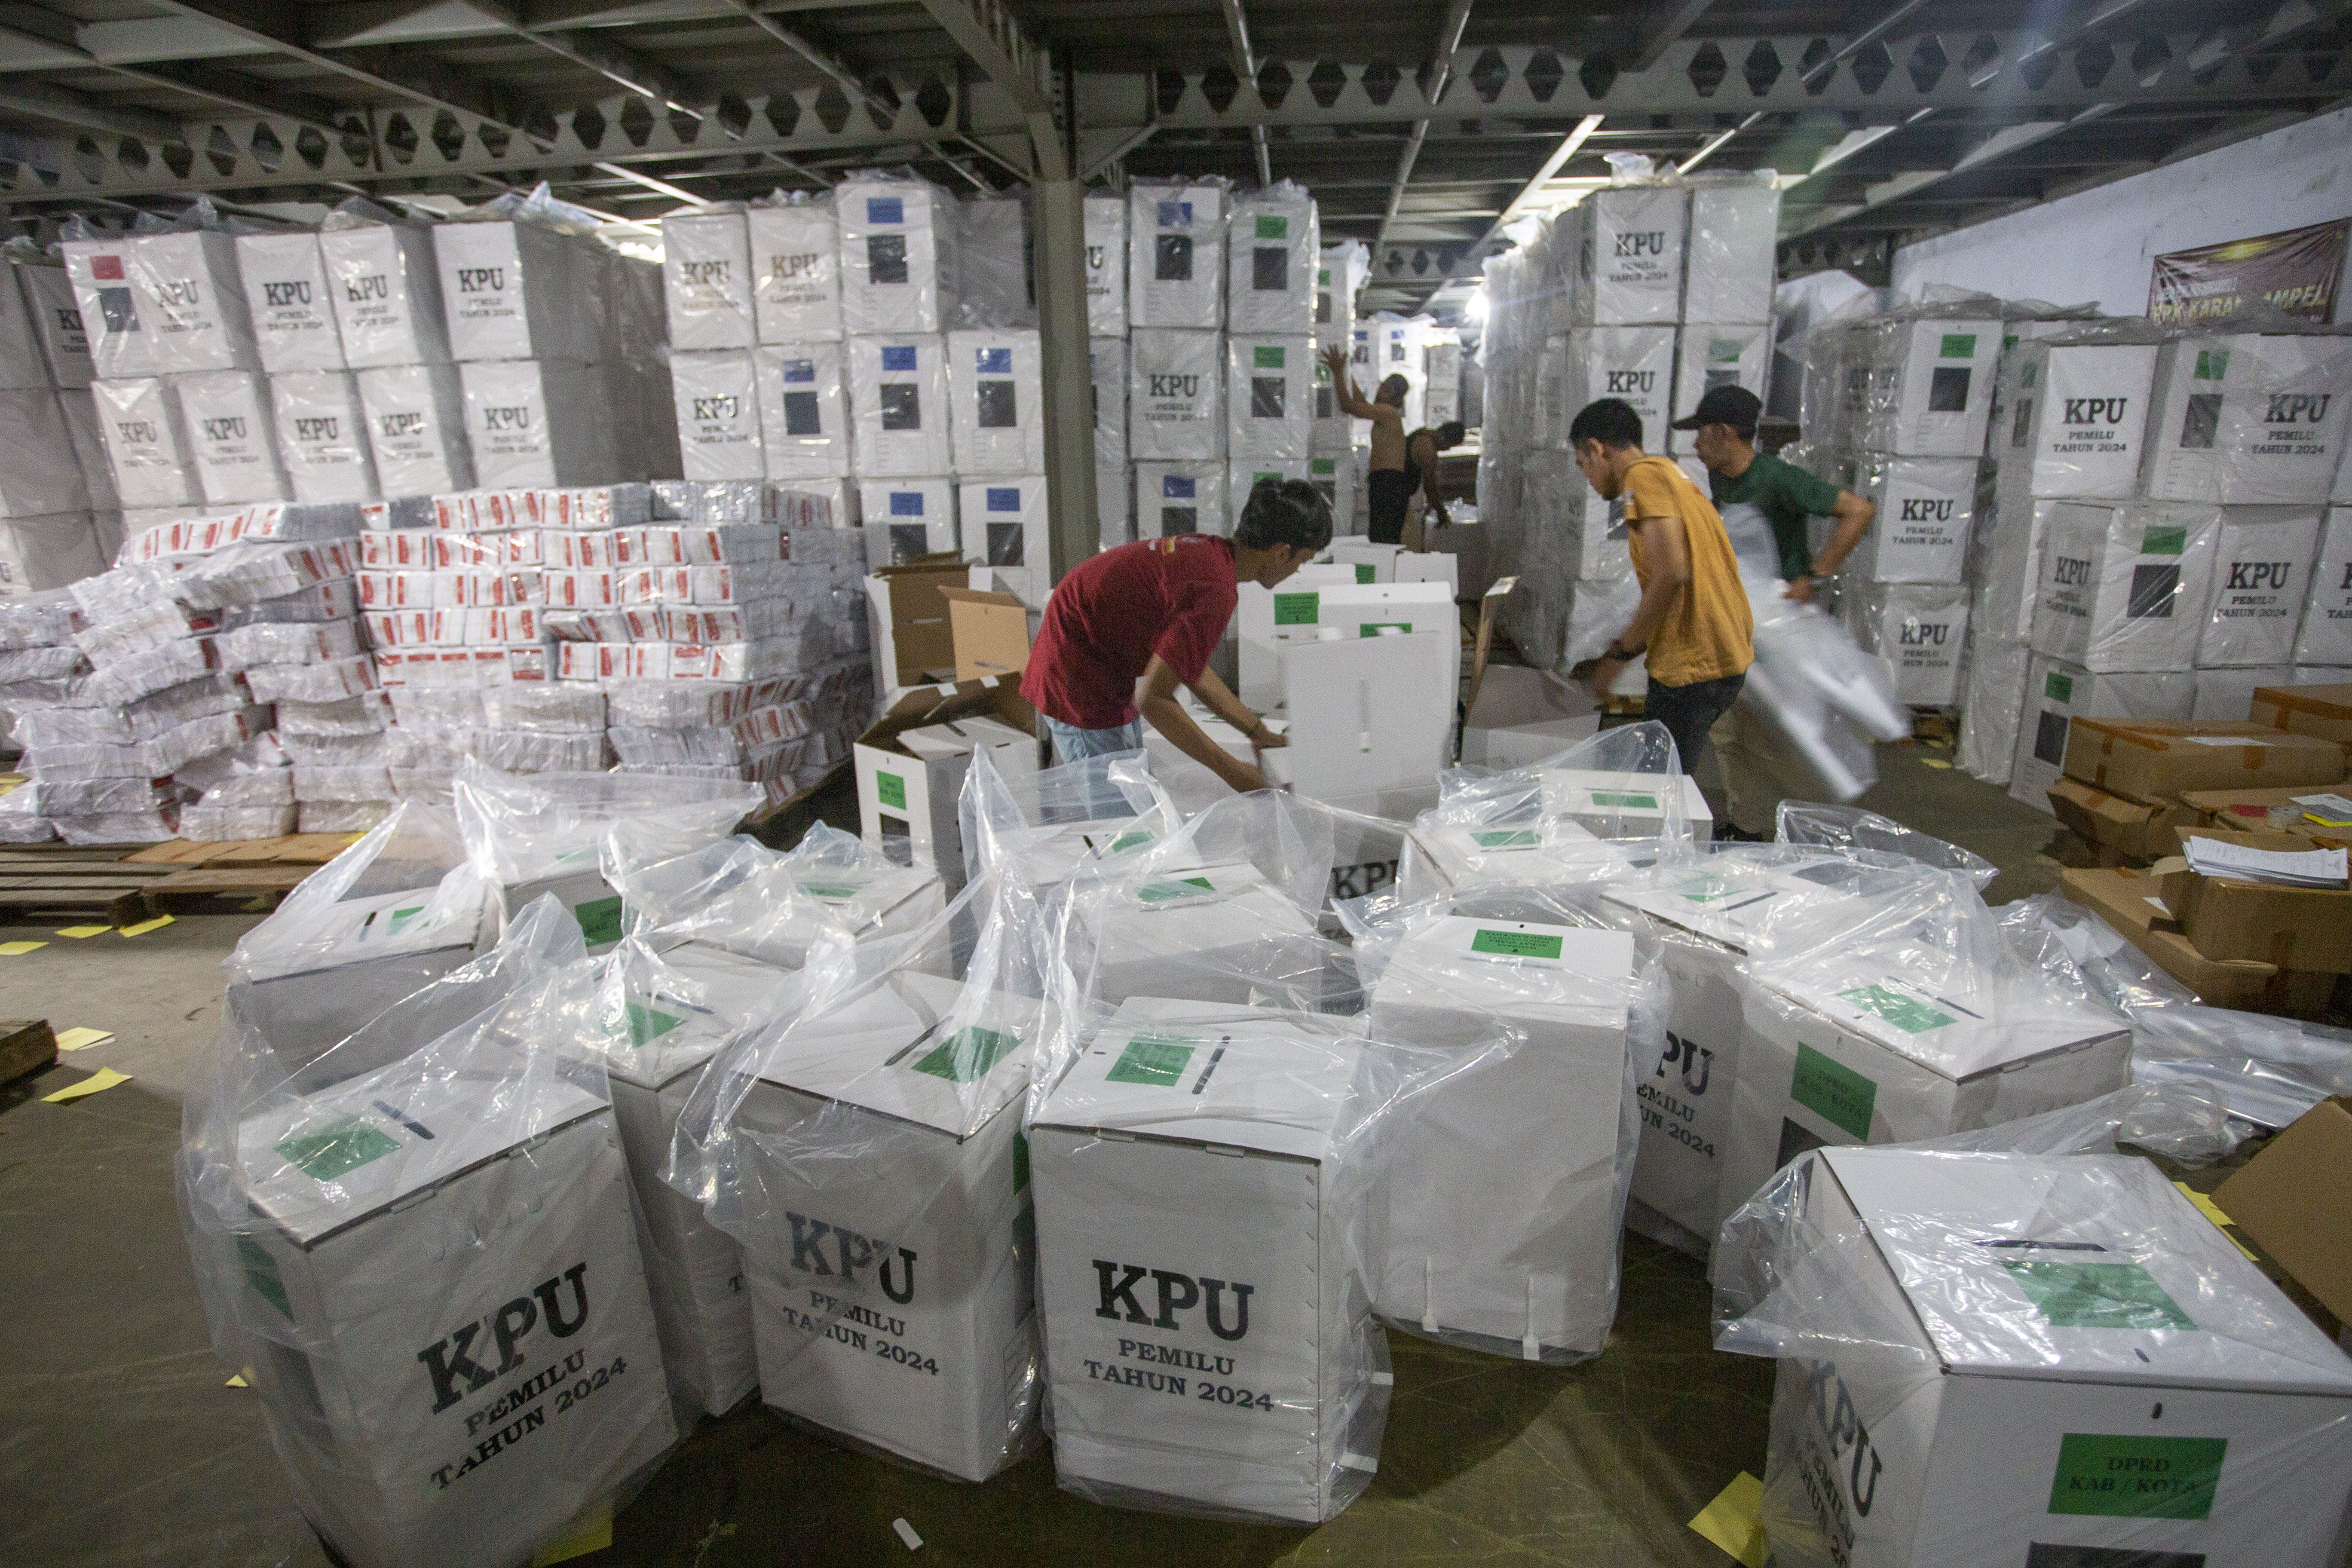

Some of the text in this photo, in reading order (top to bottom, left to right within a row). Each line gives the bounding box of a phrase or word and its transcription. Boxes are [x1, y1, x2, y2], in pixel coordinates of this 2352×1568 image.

[1614, 231, 1665, 257] KPU
[347, 275, 388, 302] KPU
[459, 268, 504, 292] KPU
[263, 281, 312, 306] KPU
[1149, 374, 1200, 398] KPU
[1607, 371, 1656, 393] KPU
[484, 407, 529, 430] KPU
[2062, 398, 2128, 425] KPU
[2263, 393, 2332, 423] KPU
[203, 416, 248, 441] KPU
[295, 417, 340, 441] KPU
[381, 412, 423, 437] KPU
[2068, 431, 2115, 440] PEMILU
[2268, 431, 2315, 440] PEMILU
[2053, 443, 2127, 453] TAHUN 2024
[2251, 445, 2325, 454] TAHUN 2024
[1901, 499, 1954, 522] KPU
[1905, 527, 1944, 536] PEMILU
[1929, 537, 1954, 545] 2024
[2054, 556, 2092, 586] KPU
[2226, 562, 2291, 589] KPU
[2258, 608, 2288, 617] 2024
[1899, 624, 1949, 646] KPU
[1332, 860, 1400, 901] KP
[1656, 1030, 1714, 1096] PU
[1636, 1083, 1695, 1123] EMILU
[1668, 1122, 1715, 1158] 2024
[786, 1210, 917, 1305] KPU
[1092, 1259, 1254, 1341] KPU
[417, 1262, 589, 1415] KPU
[875, 1339, 939, 1376] 2024
[1118, 1338, 1236, 1376] PEMILU
[463, 1348, 586, 1438] PEMILU
[1083, 1359, 1274, 1412] TAHUN 2024
[430, 1356, 628, 1491] TAHUN 2024
[2107, 1456, 2171, 1473] DPRD
[2069, 1476, 2115, 1491] KAB
[2136, 1478, 2197, 1494] KOTA
